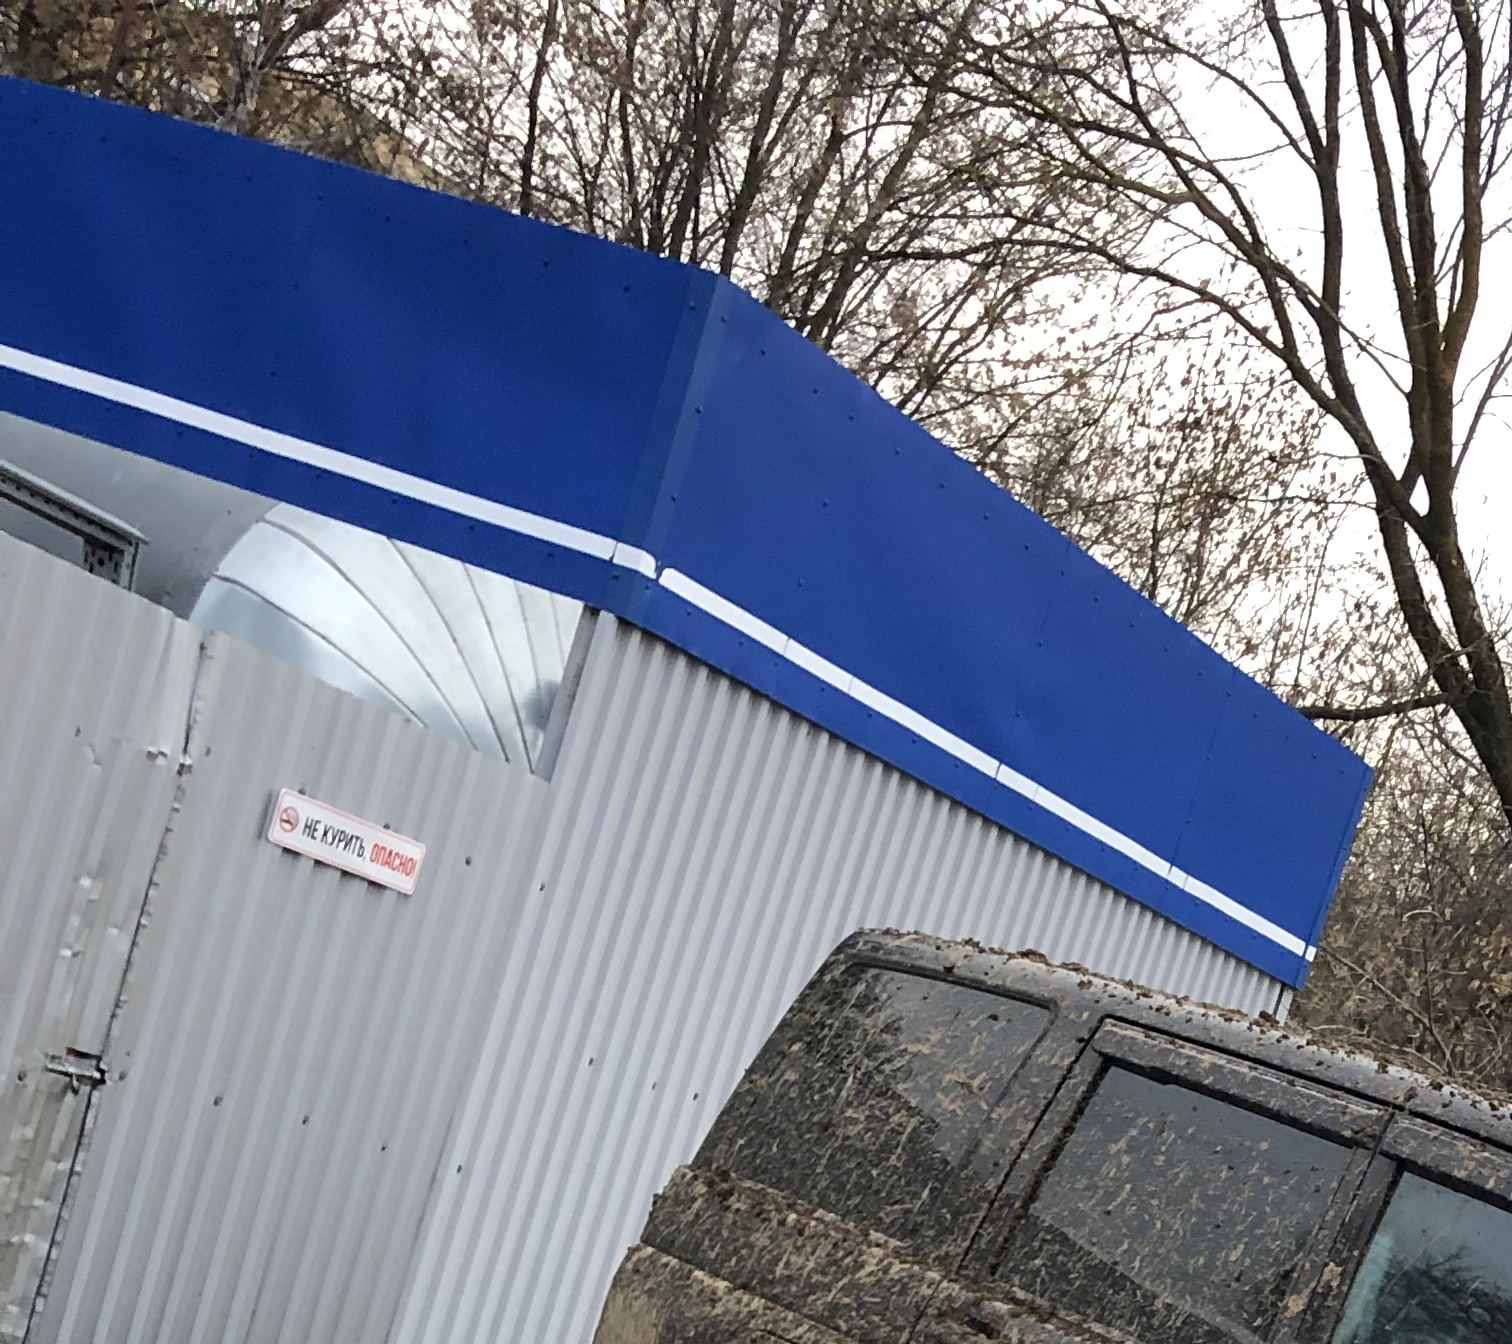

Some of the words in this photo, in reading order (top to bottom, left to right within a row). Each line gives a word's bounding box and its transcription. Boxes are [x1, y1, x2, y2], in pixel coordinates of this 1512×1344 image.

[302, 816, 321, 841] НЕ
[321, 824, 367, 862] КУРИТЬ,
[369, 842, 418, 879] ОПАСНО!
